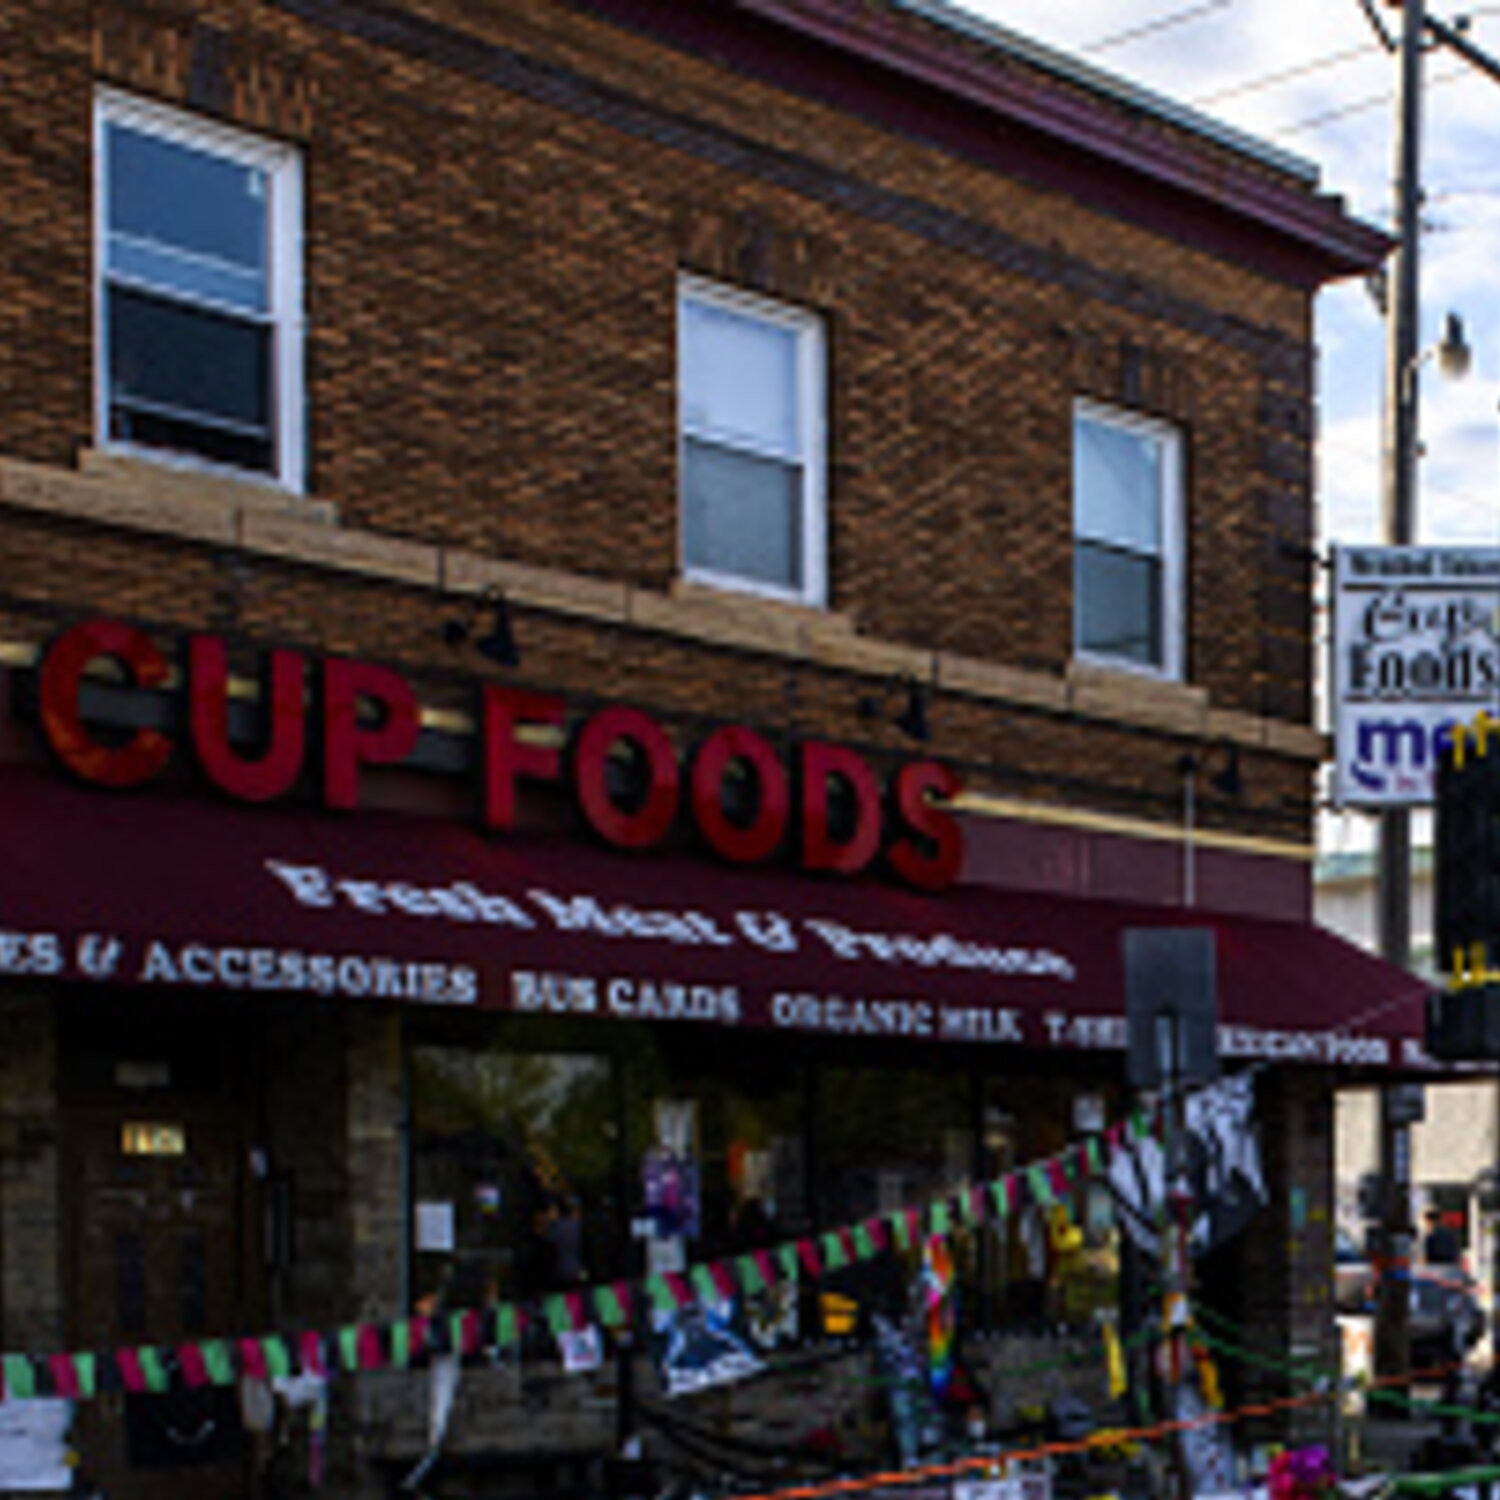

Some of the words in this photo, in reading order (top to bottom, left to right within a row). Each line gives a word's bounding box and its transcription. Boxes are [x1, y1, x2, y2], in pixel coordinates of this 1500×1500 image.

[39, 618, 419, 809] CUP
[484, 683, 966, 890] FOODS
[264, 858, 537, 928] Fresh
[527, 888, 734, 945] Meat
[76, 934, 124, 976] &
[142, 940, 478, 1004] ACCESSORIES
[511, 970, 598, 1012] BUS
[607, 978, 742, 1023] CARDS
[771, 993, 933, 1035] ORGANIC
[939, 1004, 1023, 1042] MILK
